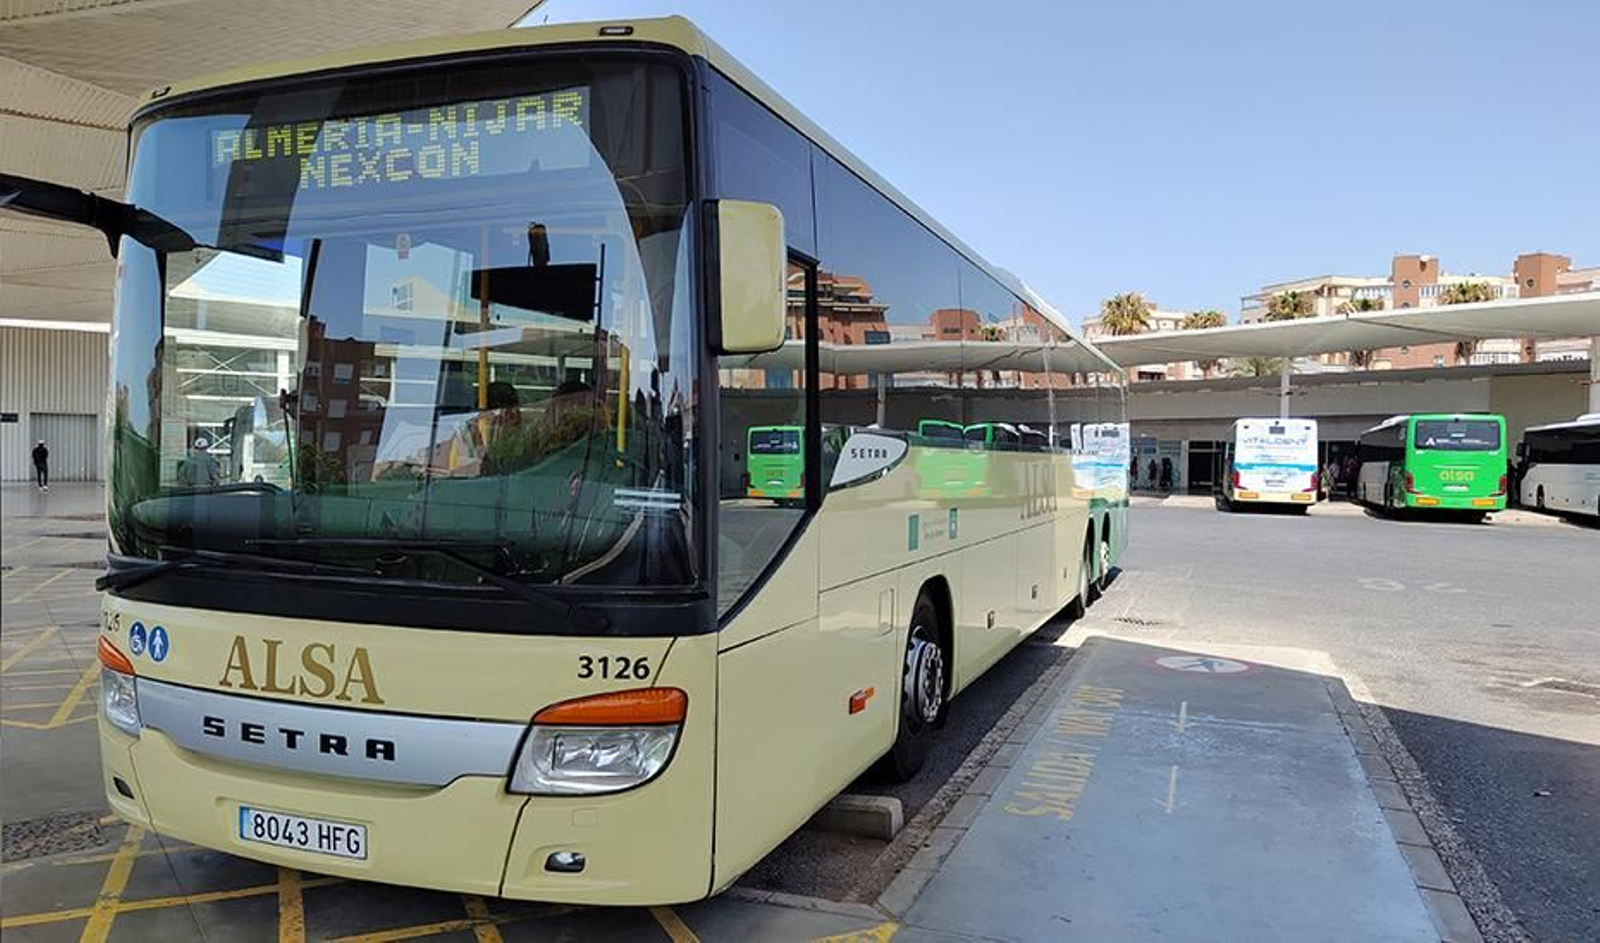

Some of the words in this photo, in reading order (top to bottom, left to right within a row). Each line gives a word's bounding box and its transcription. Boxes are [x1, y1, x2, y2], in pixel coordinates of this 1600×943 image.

[213, 91, 584, 167] ALMERIA-NIJAR
[300, 140, 480, 189] NEXCON
[851, 448, 888, 459] SETRA
[1439, 469, 1475, 481] alsa
[219, 635, 386, 705] ALSA
[577, 655, 651, 680] 3126
[203, 716, 396, 761] SETRA
[1004, 750, 1099, 821] SALIDA
[253, 813, 309, 847] 8043
[317, 823, 361, 854] HFG
